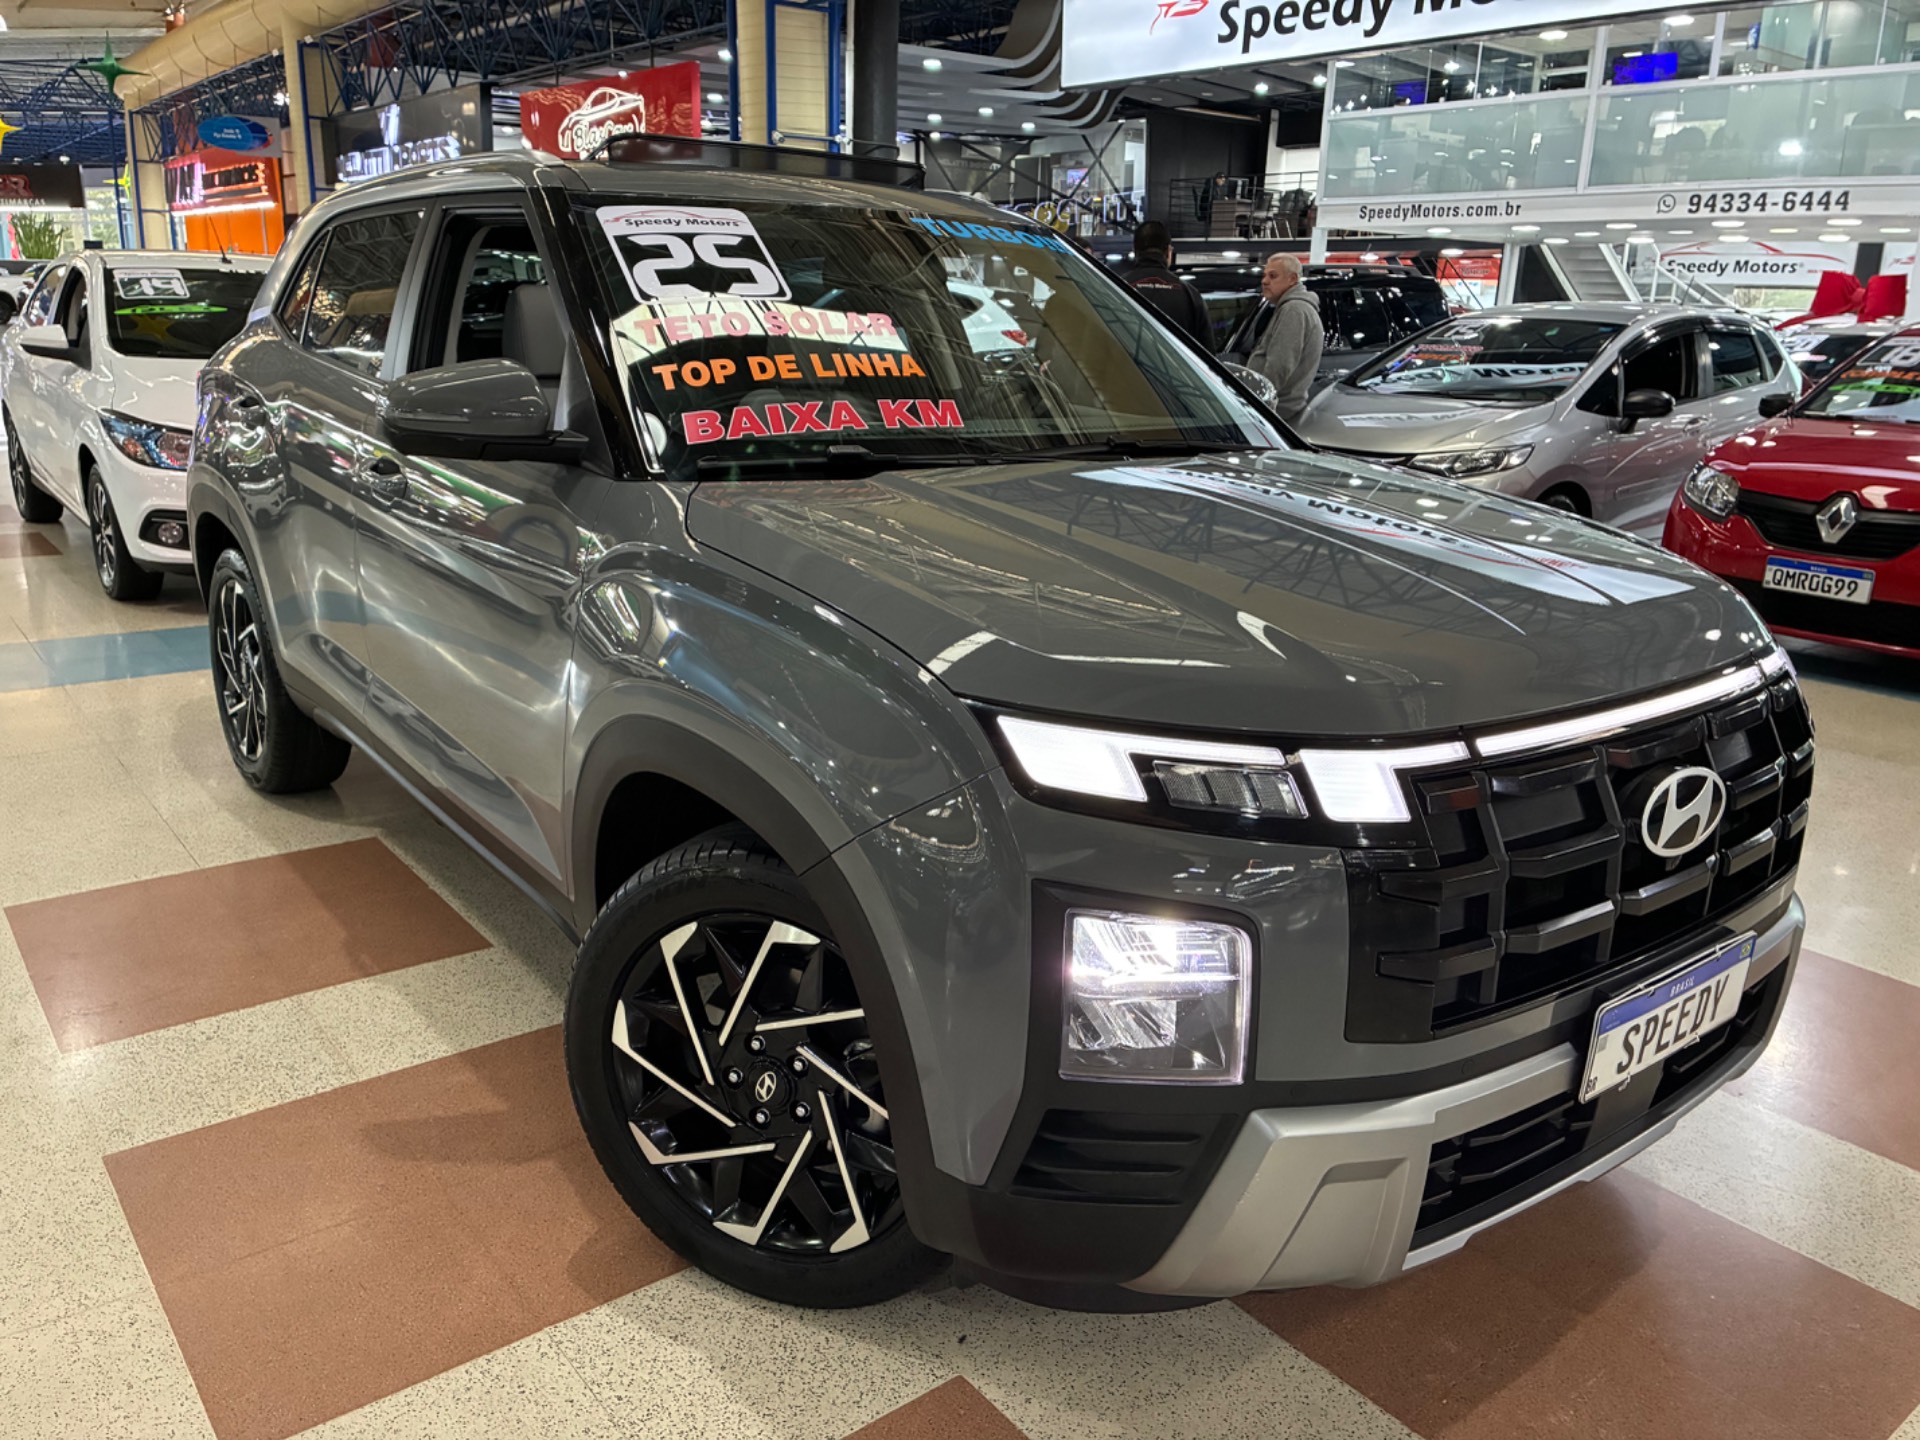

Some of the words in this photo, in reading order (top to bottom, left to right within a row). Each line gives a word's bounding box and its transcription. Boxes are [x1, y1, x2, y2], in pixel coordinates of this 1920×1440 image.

[1218, 0, 1392, 54] Speedy
[1359, 201, 1522, 222] SpeedyMotors.com.br
[1687, 190, 1851, 215] 94334-6444
[625, 217, 682, 228] Speedy
[685, 218, 740, 228] Motors
[627, 234, 780, 297] 25
[1733, 260, 1798, 274] Motors
[634, 310, 750, 346] TETO
[763, 311, 896, 337] SOLAR
[652, 358, 736, 391] TOP
[746, 354, 802, 381] DE
[809, 353, 926, 378] LINHA
[681, 400, 868, 445] BAIXA
[876, 399, 965, 429] KM
[1669, 976, 1695, 998] BRASIL
[1616, 973, 1731, 1075] SPEEDY
